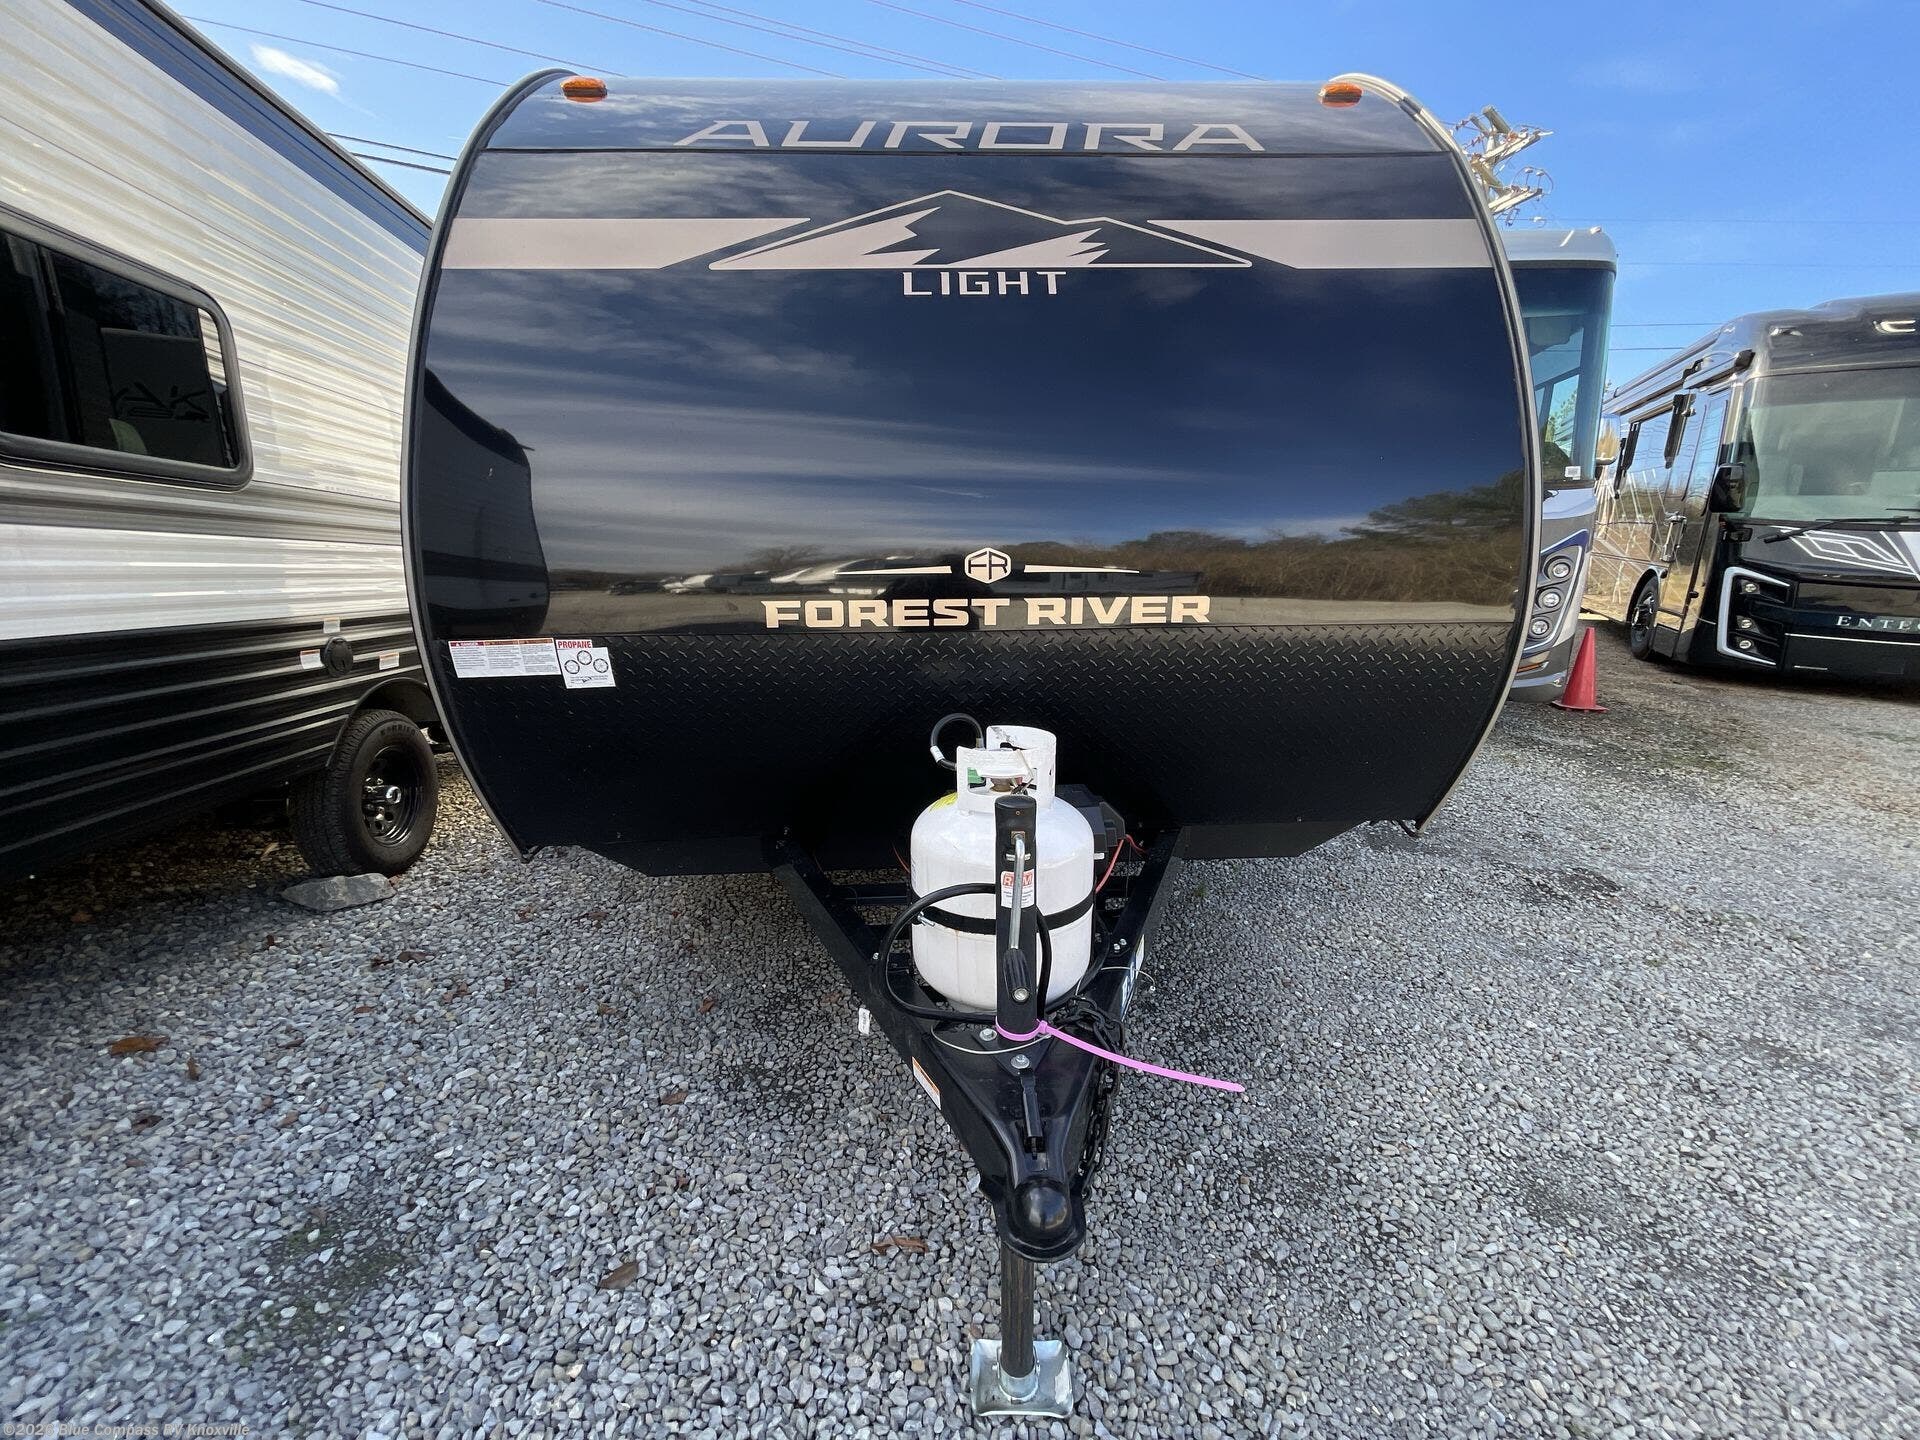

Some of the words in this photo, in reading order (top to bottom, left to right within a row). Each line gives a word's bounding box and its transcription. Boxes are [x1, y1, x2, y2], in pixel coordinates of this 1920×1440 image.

[674, 119, 1266, 151] AURORA
[903, 271, 1067, 295] LIGHT
[761, 598, 1011, 628] FOREST
[1024, 595, 1211, 625] RIVER
[1836, 615, 1920, 630] ENTE
[557, 640, 592, 649] PROPANE
[1003, 875, 1032, 887] RM
